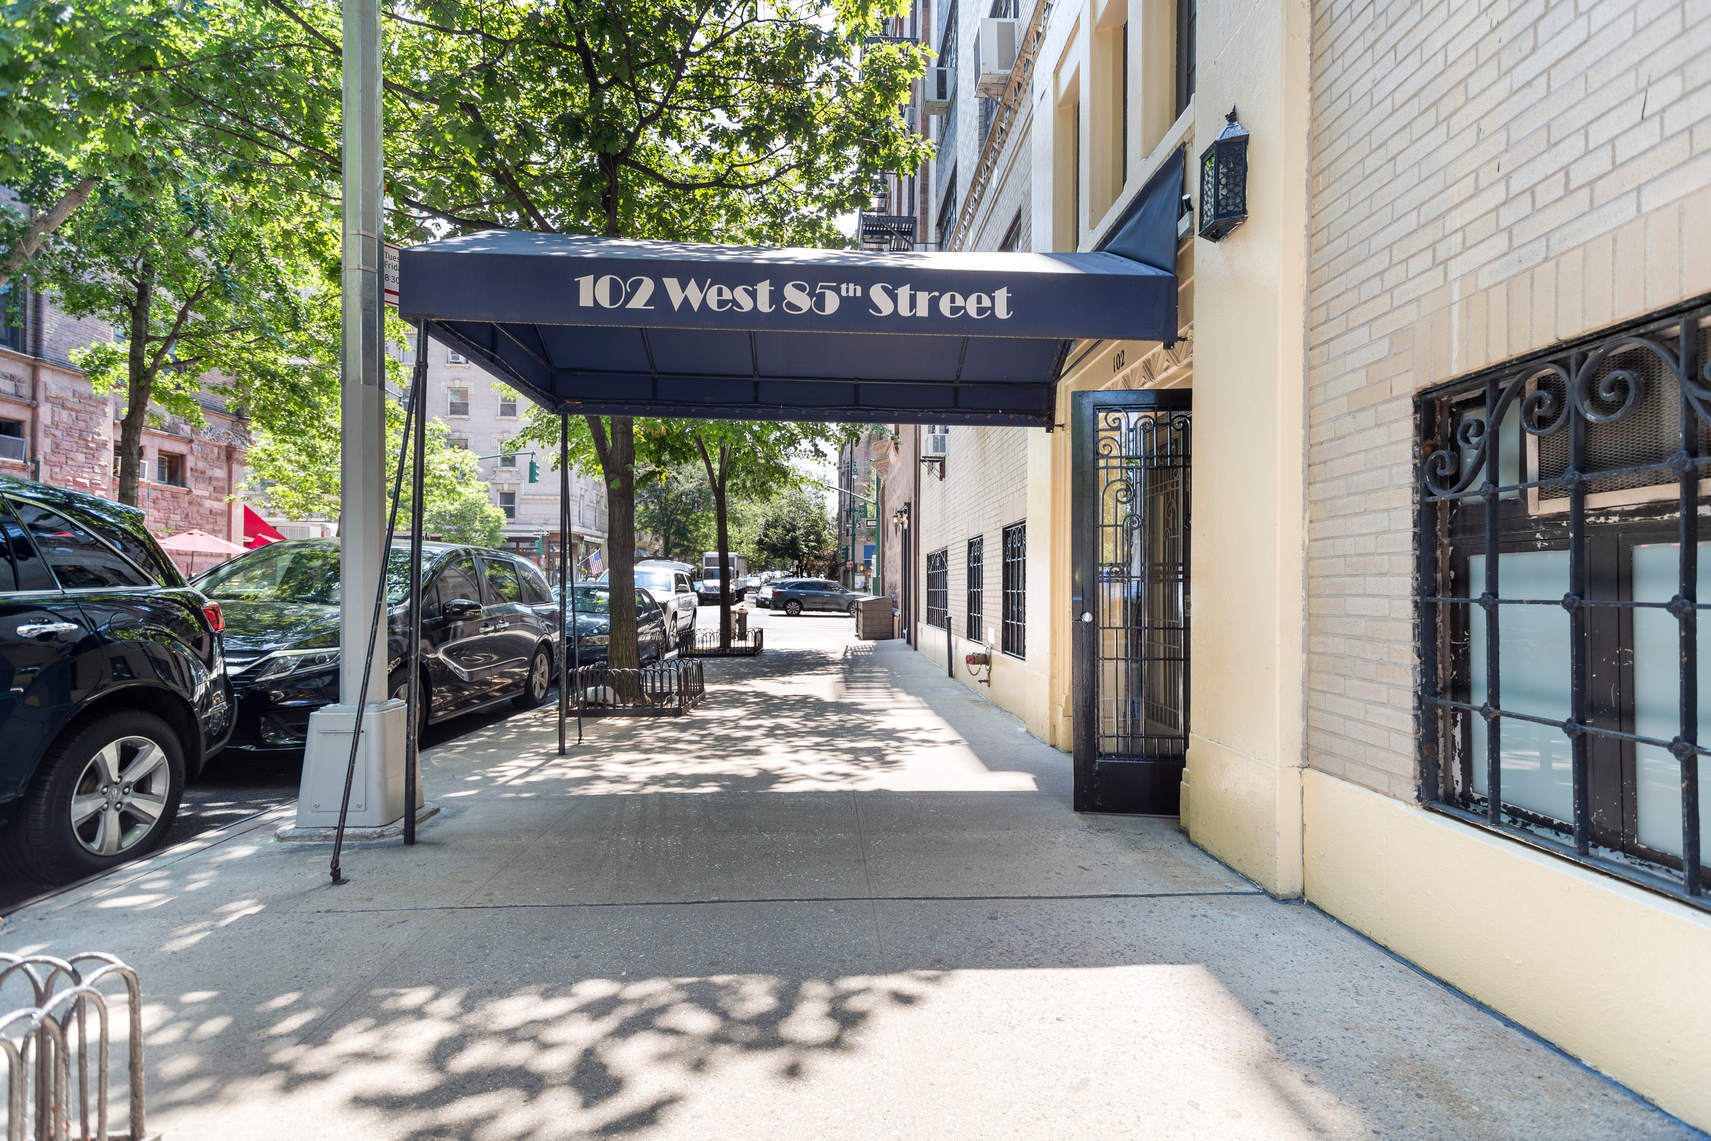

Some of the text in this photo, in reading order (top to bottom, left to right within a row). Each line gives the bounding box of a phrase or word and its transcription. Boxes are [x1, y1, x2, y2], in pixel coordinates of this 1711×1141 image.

[384, 261, 400, 272] Frid
[574, 274, 1014, 320] 102 West 85th Street
[1113, 350, 1125, 373] 102
